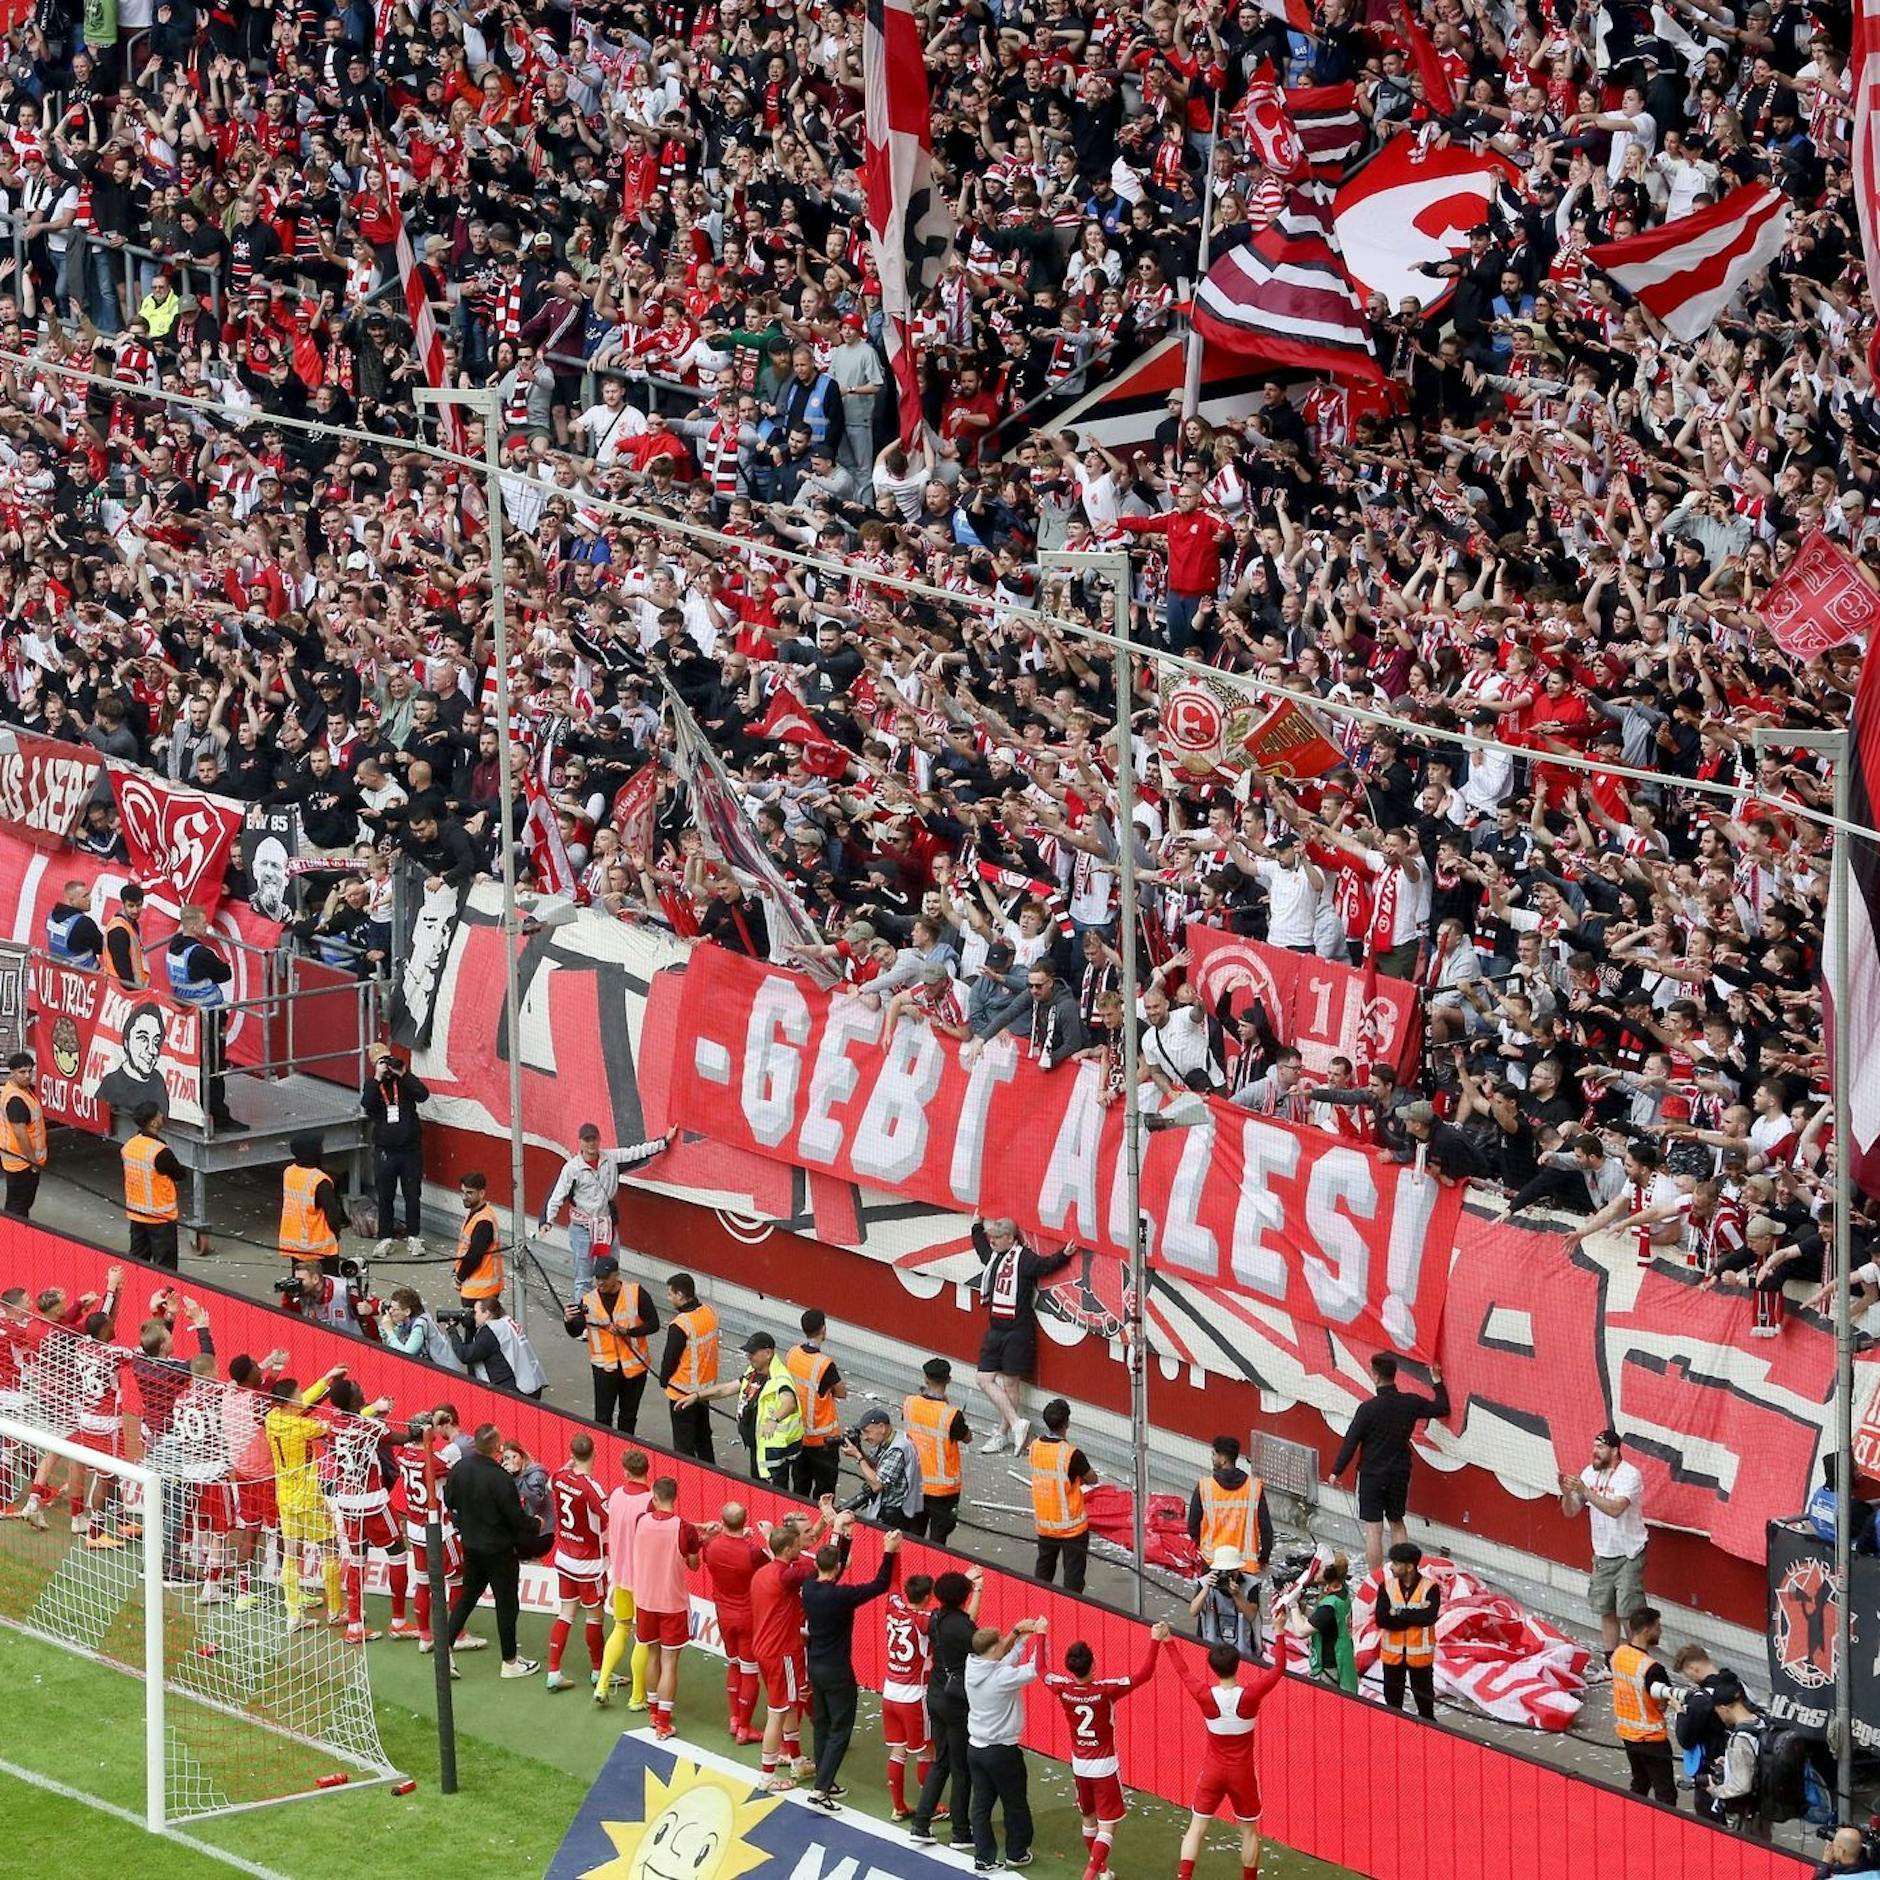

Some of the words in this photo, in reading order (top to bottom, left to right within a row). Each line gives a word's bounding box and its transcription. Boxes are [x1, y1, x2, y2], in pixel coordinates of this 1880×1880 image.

[270, 814, 289, 832] 85
[38, 964, 97, 1020] ULTRAS
[1038, 1058, 1438, 1349] ALLES!
[559, 1491, 575, 1530] 3
[887, 1621, 915, 1662] 23
[1073, 1704, 1096, 1738] 2
